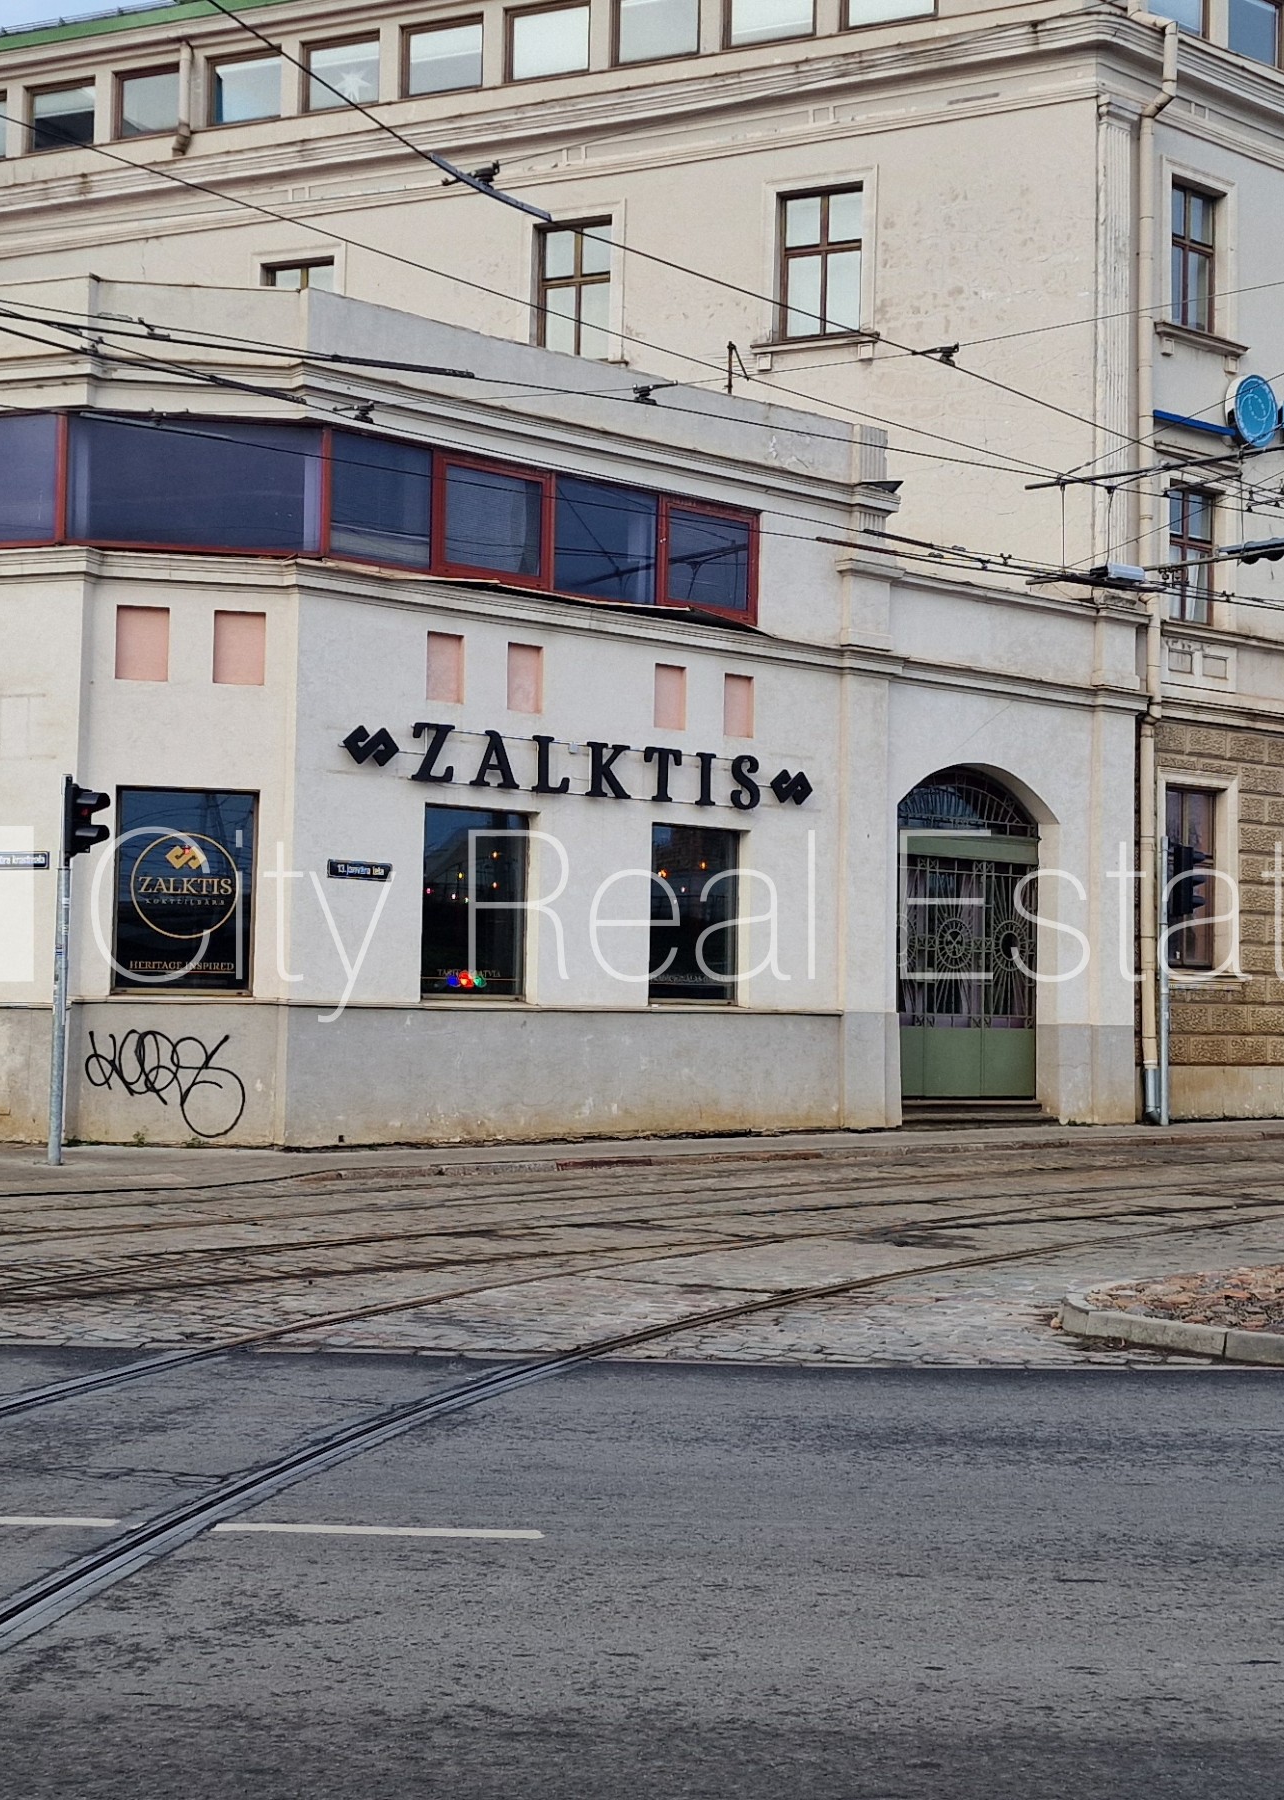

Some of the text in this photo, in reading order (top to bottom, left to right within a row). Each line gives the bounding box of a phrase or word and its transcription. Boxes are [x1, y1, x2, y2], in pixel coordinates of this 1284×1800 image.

[412, 722, 761, 810] ZALKTIS
[138, 876, 233, 895] ZALKTIS
[129, 960, 234, 971] HERITAGE INSPIRED
